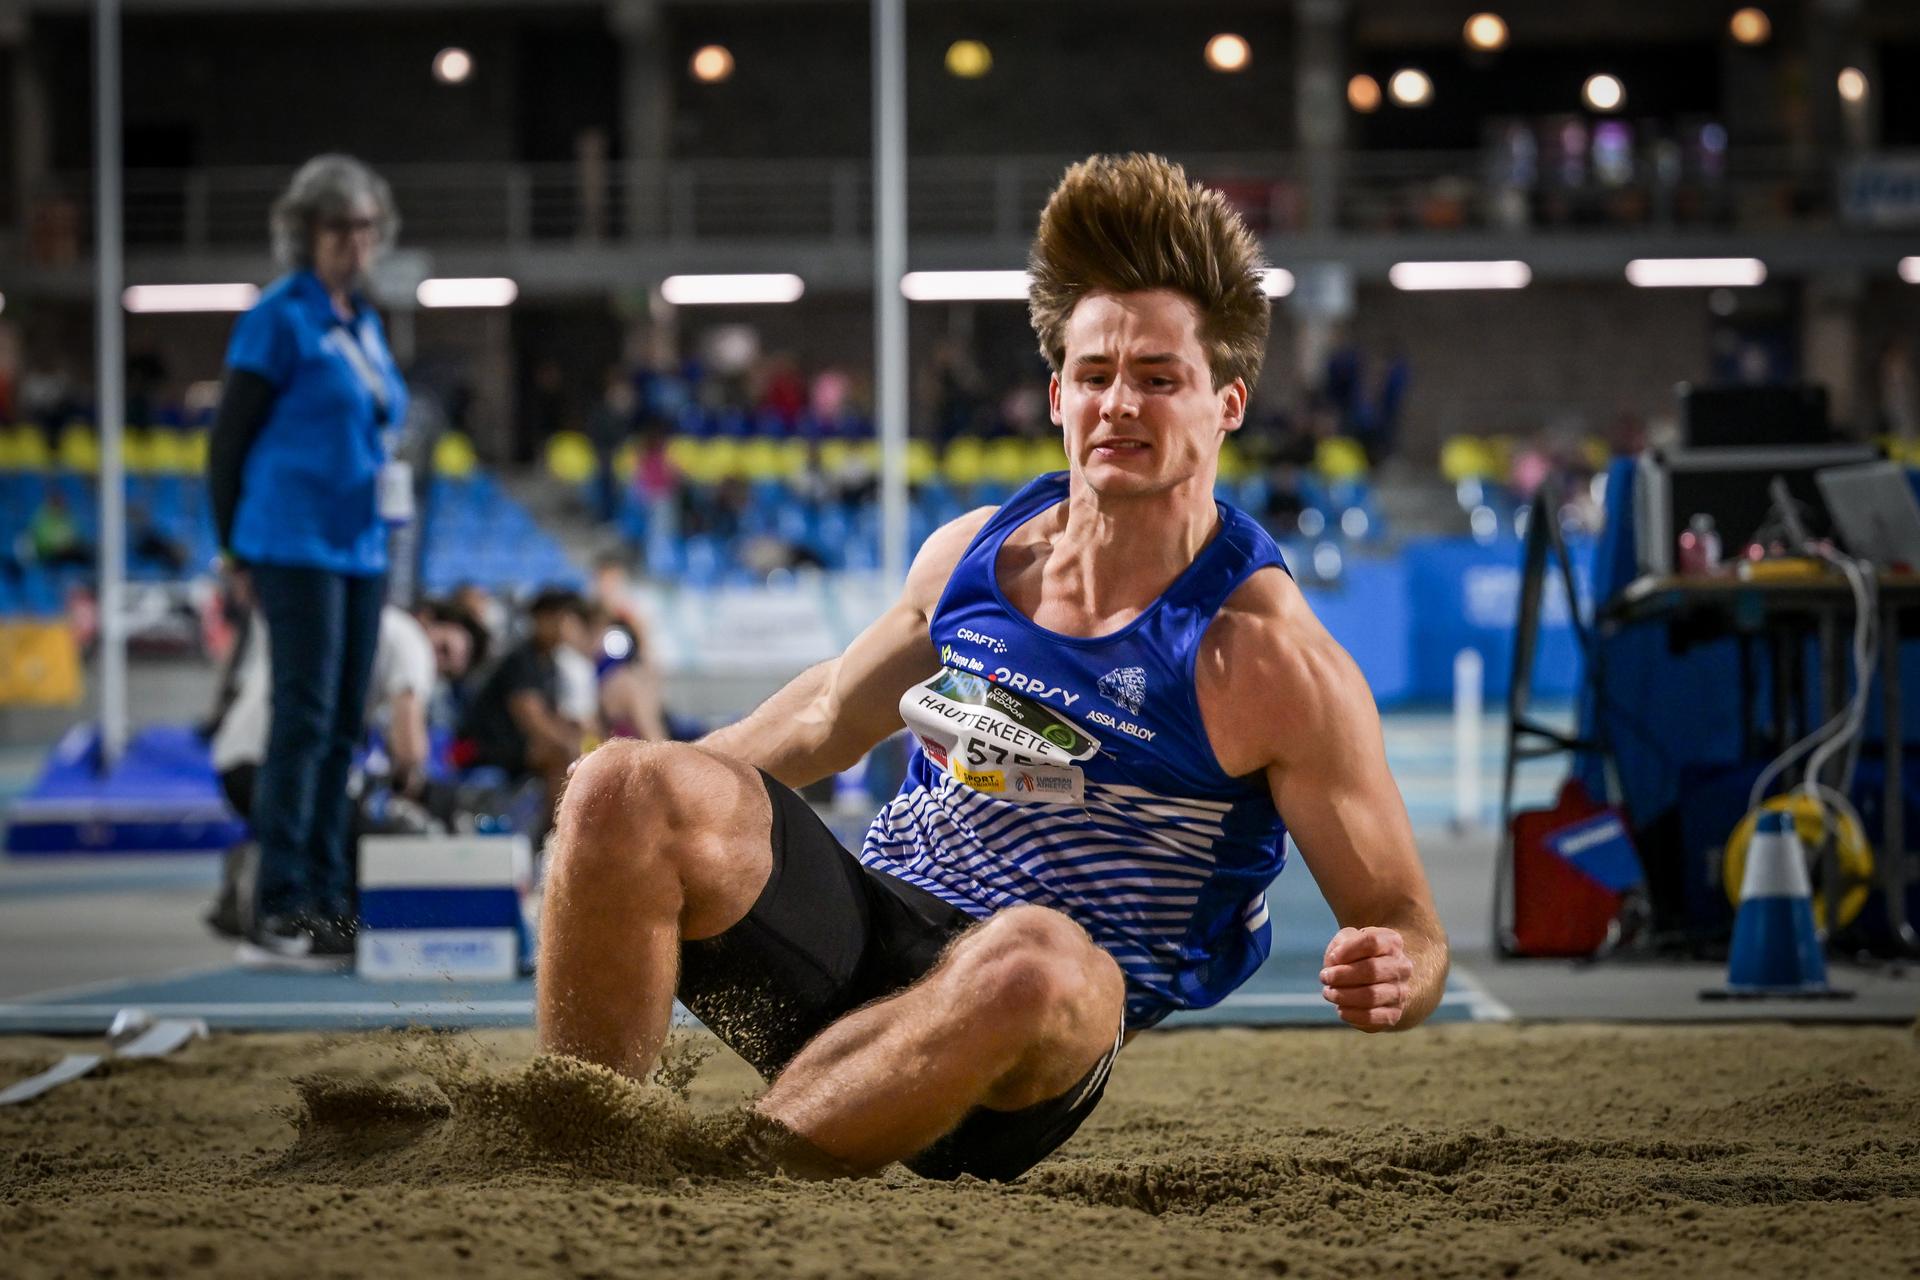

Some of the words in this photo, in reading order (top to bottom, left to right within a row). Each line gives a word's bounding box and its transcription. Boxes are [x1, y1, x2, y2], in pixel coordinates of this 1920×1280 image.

[957, 628, 996, 648] CRAFT
[951, 651, 969, 668] Kappa
[987, 691, 1025, 720] INDOOR
[993, 688, 1022, 708] GENT
[918, 695, 1054, 755] HAUTTEKEETE
[1086, 710, 1115, 729] ASSA
[1117, 721, 1156, 742] ABLOY
